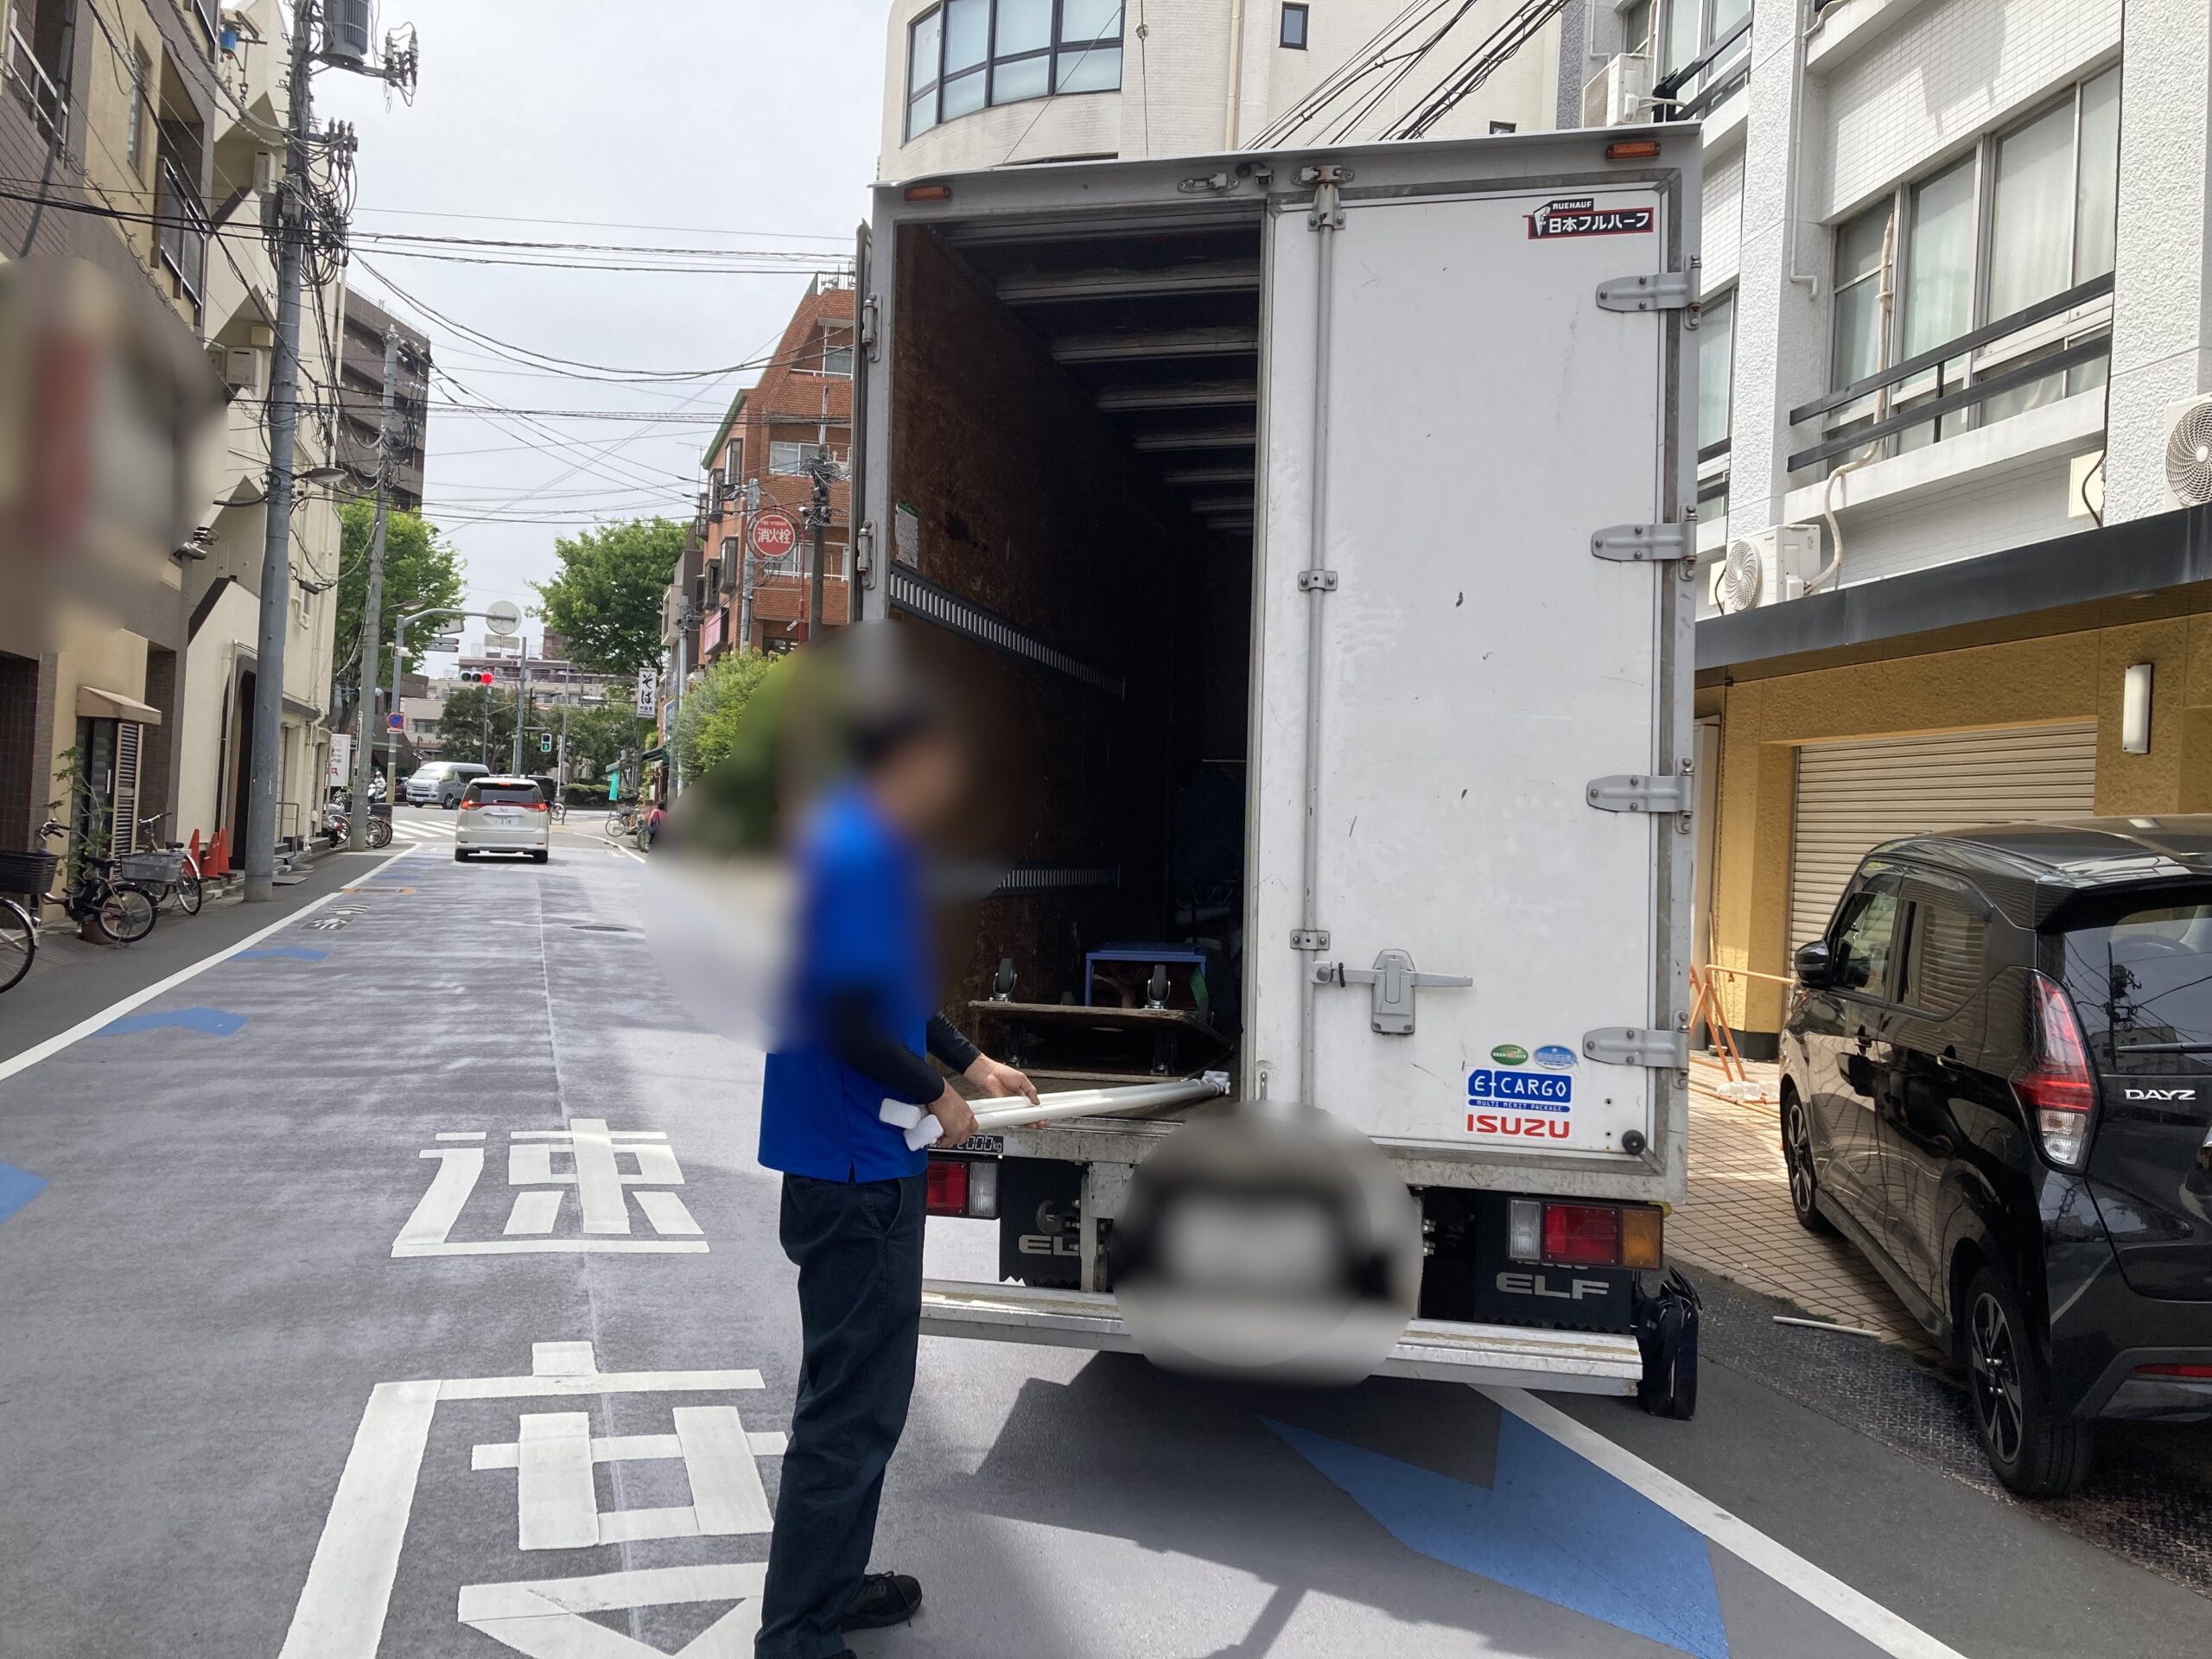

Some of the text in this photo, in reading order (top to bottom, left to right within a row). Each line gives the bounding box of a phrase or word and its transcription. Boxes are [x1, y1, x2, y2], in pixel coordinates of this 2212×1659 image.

[1548, 212, 1649, 233] 日本フルハーフ
[757, 527, 791, 544] 消火栓
[640, 673, 653, 705] そば
[1474, 1075, 1567, 1097] E-CARGO
[2124, 1089, 2196, 1100] DAYZ
[1503, 1102, 1527, 1110] MERIT
[1530, 1103, 1563, 1113] PACKAGE
[1467, 1114, 1570, 1139] ISUZU
[1018, 1234, 1081, 1256] EL
[1496, 1272, 1610, 1300] ELF
